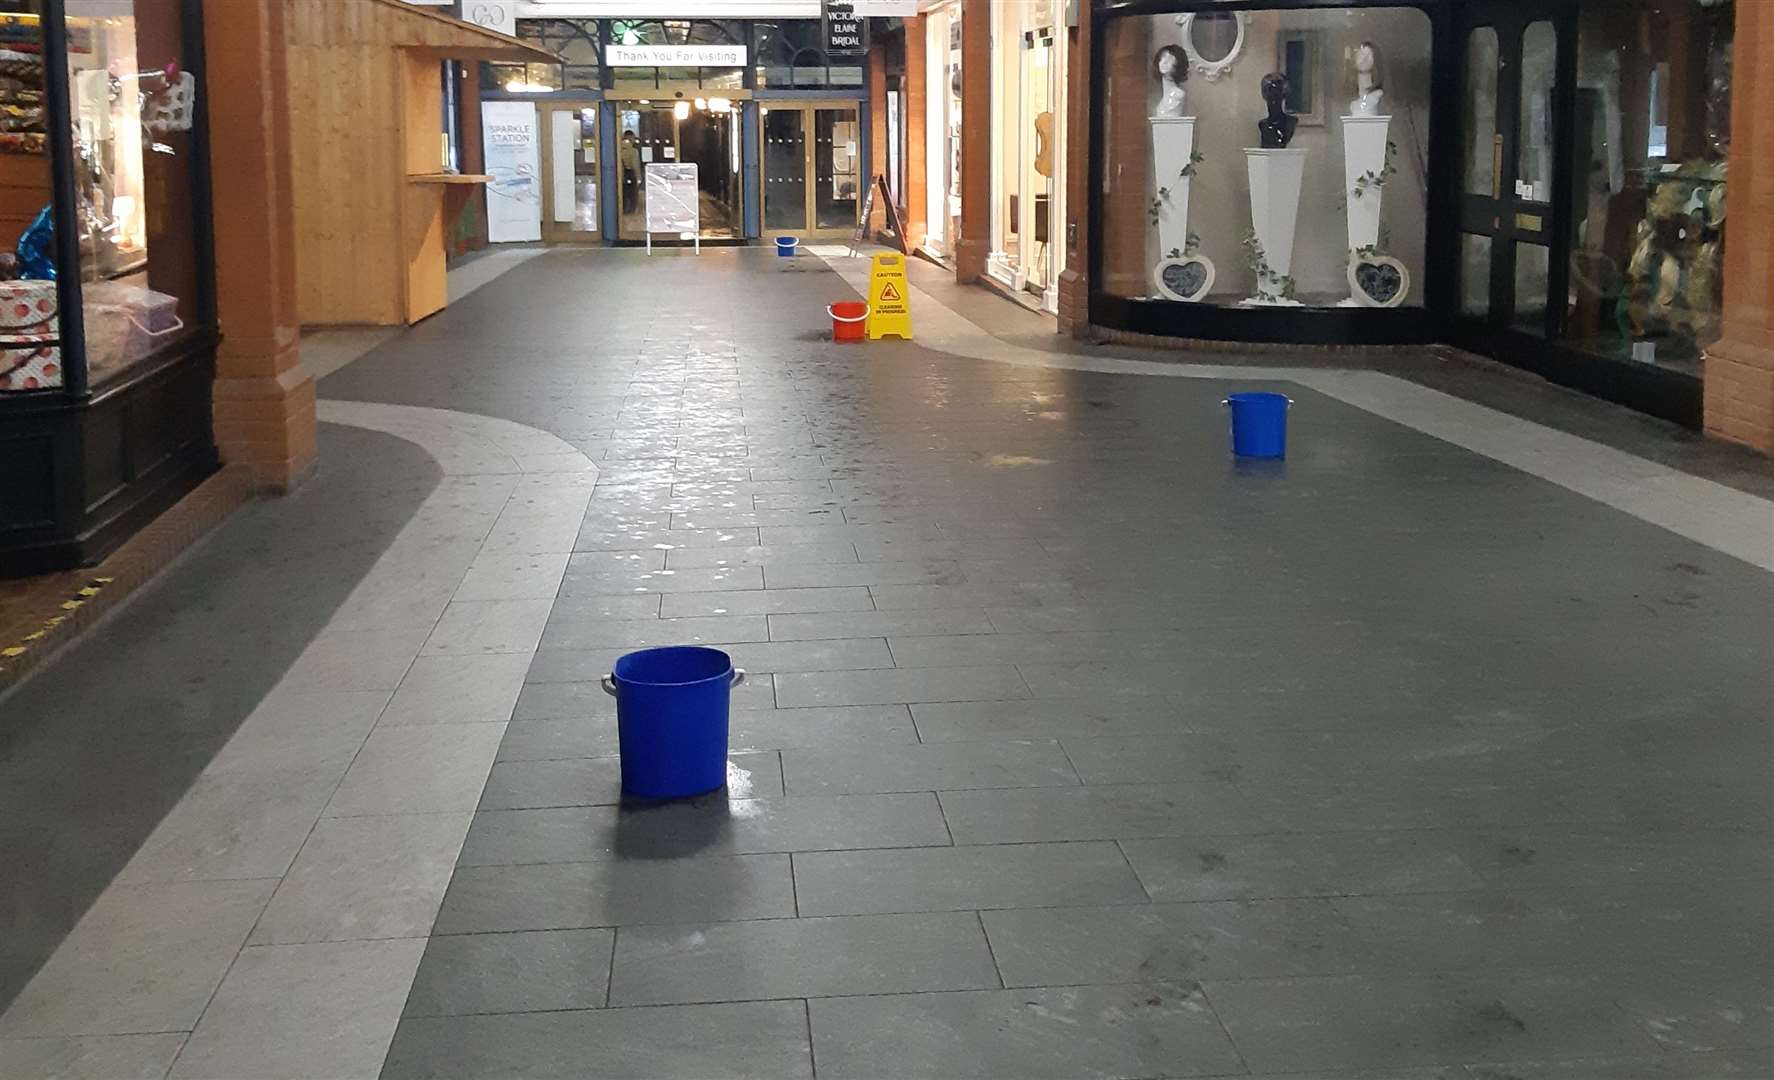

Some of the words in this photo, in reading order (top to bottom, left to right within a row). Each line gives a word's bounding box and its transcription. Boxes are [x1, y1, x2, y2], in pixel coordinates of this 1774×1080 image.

[834, 24, 857, 33] ELAINE
[831, 36, 860, 46] BRIDAL
[617, 50, 649, 61] Thank
[652, 50, 672, 61] You
[676, 50, 694, 61] For
[698, 50, 737, 63] Visiting
[489, 125, 530, 133] SPARKLE
[490, 134, 530, 142] STATION
